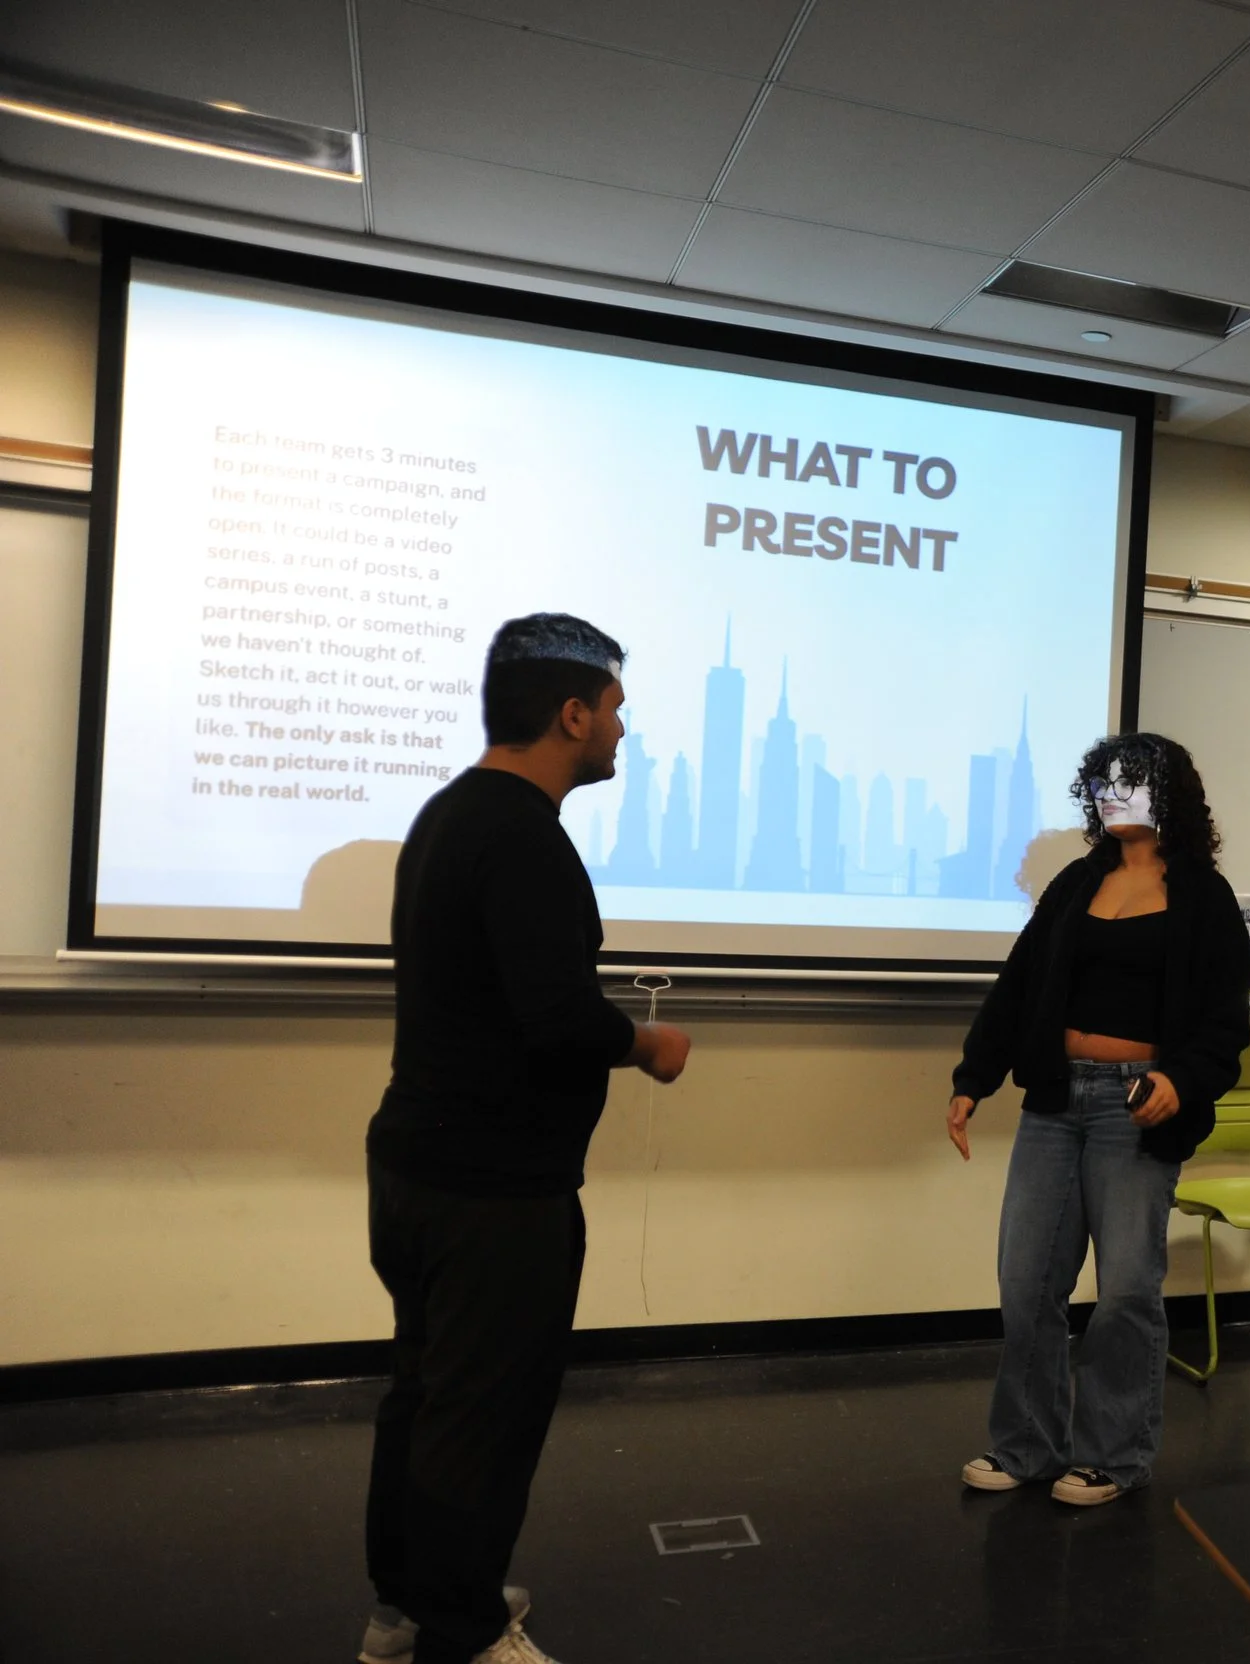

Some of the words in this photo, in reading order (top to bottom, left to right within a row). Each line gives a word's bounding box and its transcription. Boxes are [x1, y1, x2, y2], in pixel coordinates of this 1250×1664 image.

[214, 425, 266, 447] Each
[275, 436, 326, 454] team
[332, 444, 375, 462] gets
[381, 448, 393, 463] 3
[400, 452, 476, 474] minutes
[696, 425, 872, 488] WHAT
[883, 450, 957, 500] TO
[214, 456, 233, 472] to
[241, 460, 319, 482] present
[326, 471, 336, 484] a
[343, 473, 444, 498] campaign,
[450, 486, 486, 502] and
[211, 486, 245, 503] the
[254, 488, 321, 511] format
[329, 502, 343, 513] is
[350, 503, 458, 529] completely
[208, 517, 266, 534] open.
[274, 521, 286, 536] It
[293, 524, 348, 543] could
[355, 529, 378, 546] be
[384, 536, 394, 548] a
[400, 537, 452, 555] video
[704, 503, 958, 572] PRESENT
[207, 546, 276, 565] series,
[283, 553, 293, 566] a
[301, 555, 333, 570] run
[339, 557, 358, 572] of
[364, 561, 423, 580] posts,
[429, 568, 439, 580] a
[204, 576, 288, 595] campus
[294, 582, 354, 602] event,
[360, 590, 370, 602] a
[377, 591, 431, 609] stunt,
[438, 598, 448, 610] a
[202, 605, 331, 629] partnership,
[337, 615, 356, 628] or
[363, 620, 465, 643] something
[201, 634, 231, 648] we
[237, 633, 312, 654] haven't
[320, 641, 396, 663] thought
[402, 647, 425, 663] of.
[200, 660, 273, 680] Sketch
[280, 665, 299, 683] it,
[305, 670, 337, 685] act
[344, 671, 356, 686] it
[363, 674, 399, 691] out,
[404, 679, 424, 692] or
[429, 679, 473, 696] walk
[197, 693, 221, 707] us
[228, 692, 311, 715] through
[317, 697, 330, 713] it
[337, 699, 418, 719] however
[424, 709, 457, 724] you
[195, 718, 238, 737] like.
[245, 722, 284, 739] The
[290, 725, 334, 744] only
[340, 726, 375, 744] ask
[381, 729, 397, 745] is
[403, 731, 442, 750] that
[194, 752, 224, 766] we
[229, 754, 268, 768] can
[273, 753, 349, 773] picture
[354, 757, 368, 773] it
[374, 760, 451, 781] running
[192, 777, 211, 795] in
[218, 779, 253, 796] the
[258, 782, 300, 799] real
[306, 785, 369, 802] world.
